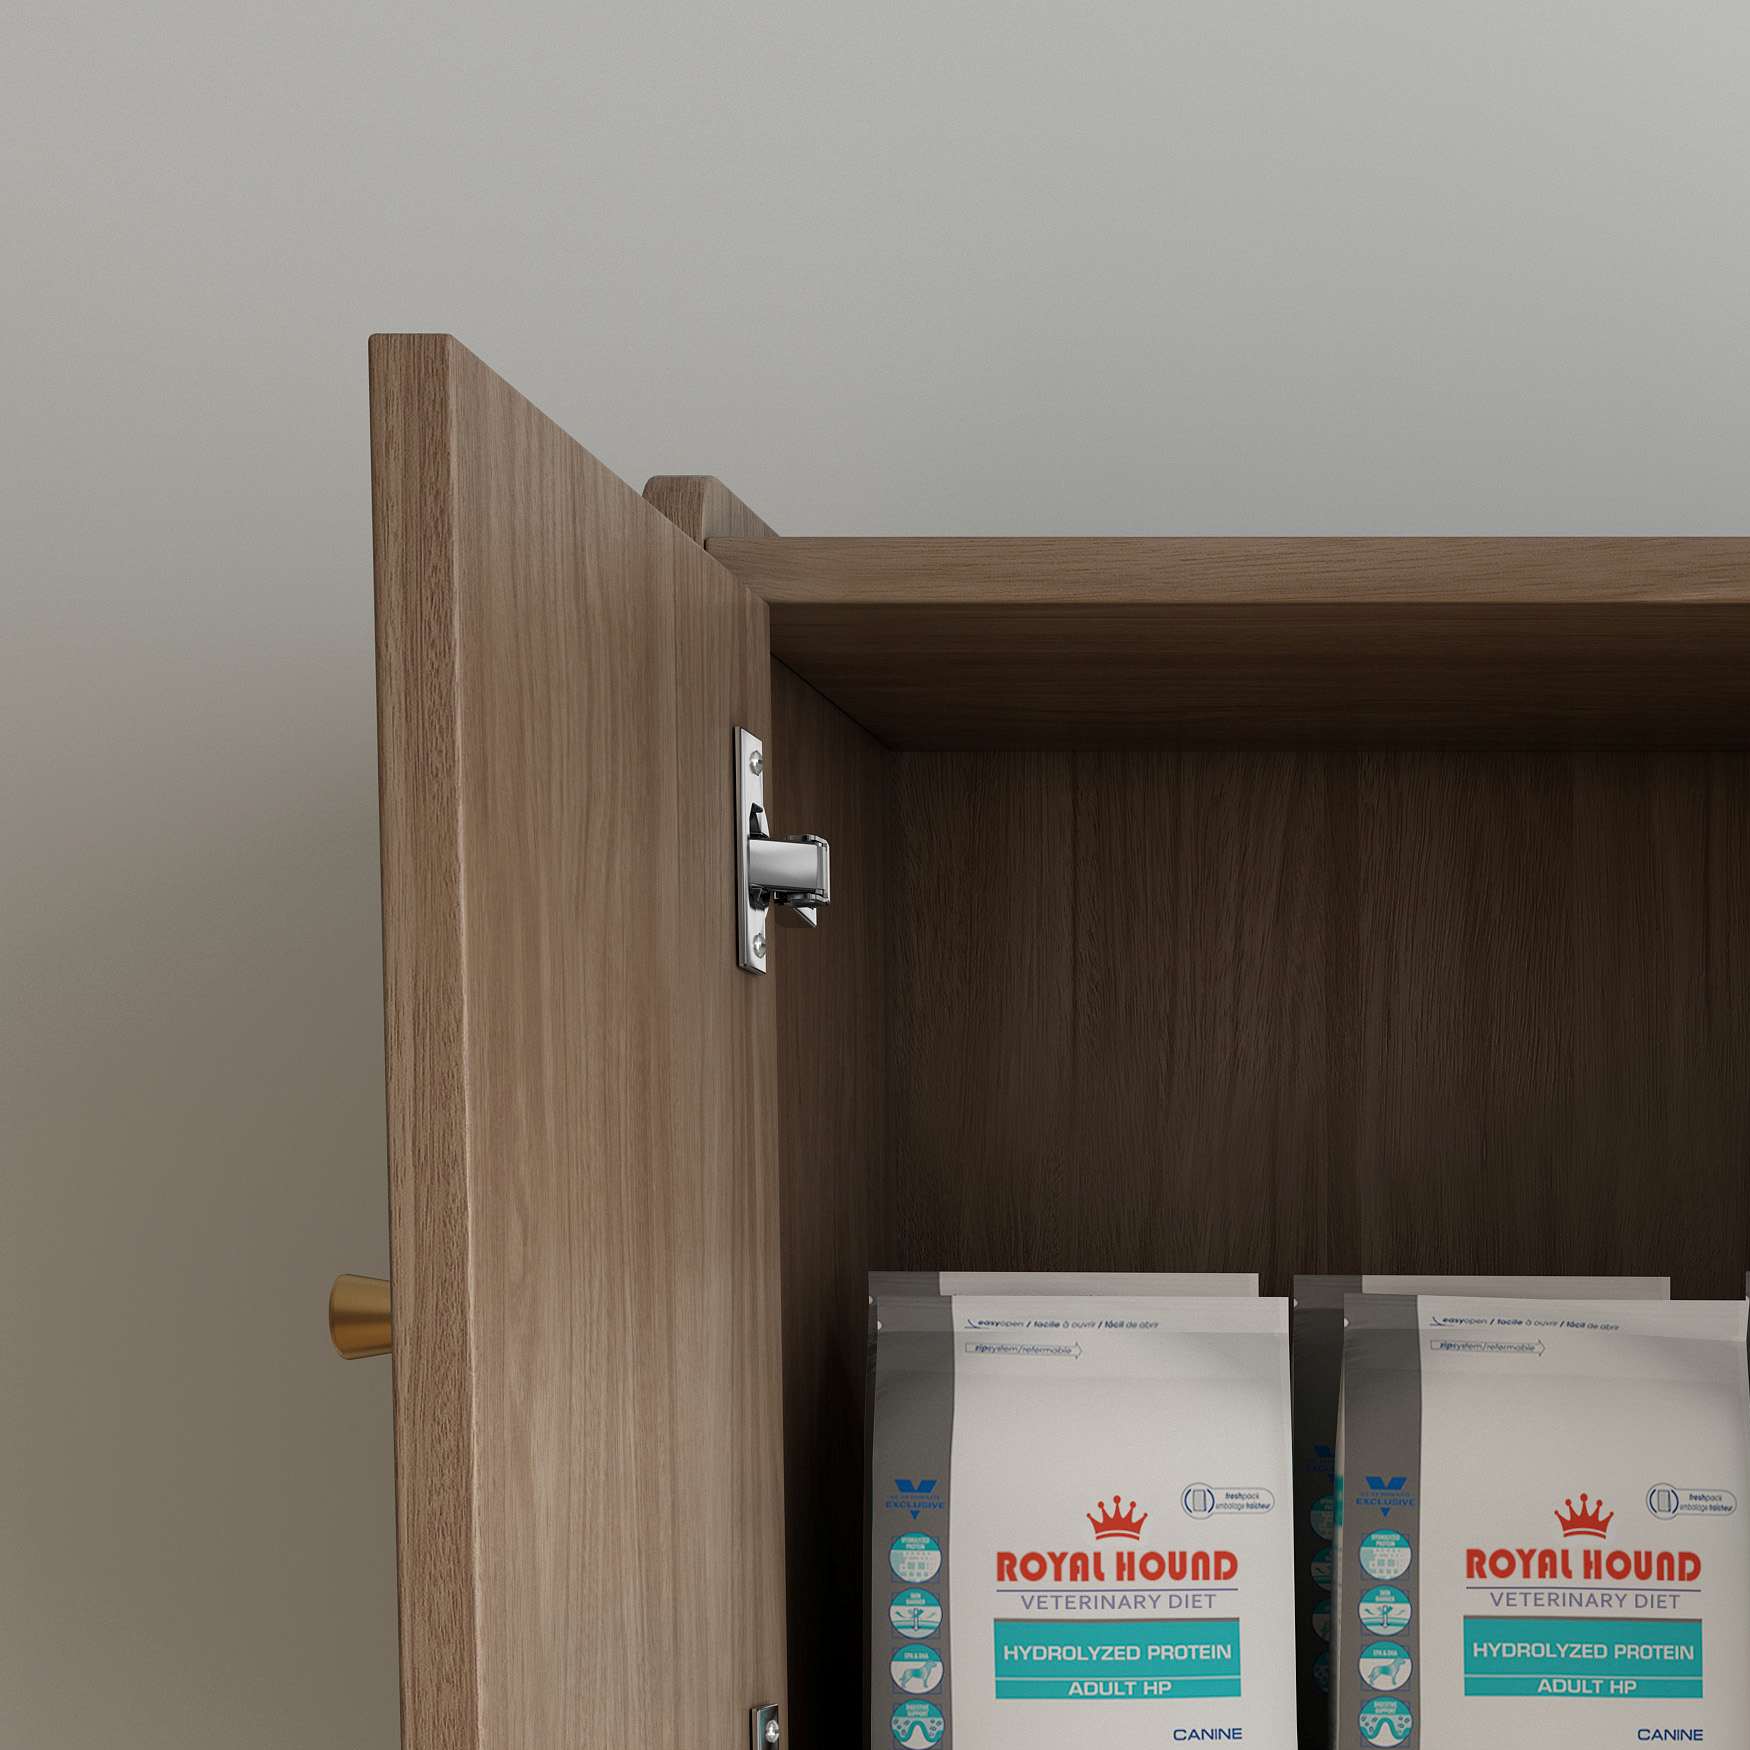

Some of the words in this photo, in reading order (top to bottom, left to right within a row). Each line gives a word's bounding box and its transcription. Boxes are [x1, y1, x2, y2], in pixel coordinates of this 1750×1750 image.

[996, 1552, 1104, 1583] ROYAL
[1116, 1551, 1238, 1581] HOUND
[1466, 1548, 1573, 1580] ROYAL
[1584, 1549, 1701, 1582] HOUND
[1021, 1594, 1161, 1610] VETERINARY
[1169, 1594, 1216, 1608] DIET
[1490, 1592, 1627, 1608] VETERINARY
[1635, 1593, 1680, 1609] DIET
[1004, 1645, 1141, 1661] HYDROLYZED
[1148, 1644, 1231, 1660] PROTEIN
[1473, 1642, 1608, 1659] HYDROLYZED
[1614, 1644, 1694, 1660] PROTEIN
[1069, 1681, 1137, 1696] ADULT
[1144, 1681, 1171, 1695] HP
[1538, 1679, 1604, 1694] ADULT
[1610, 1680, 1636, 1694] HP
[1173, 1728, 1242, 1740] CANINE
[1638, 1729, 1703, 1741] CANINE
